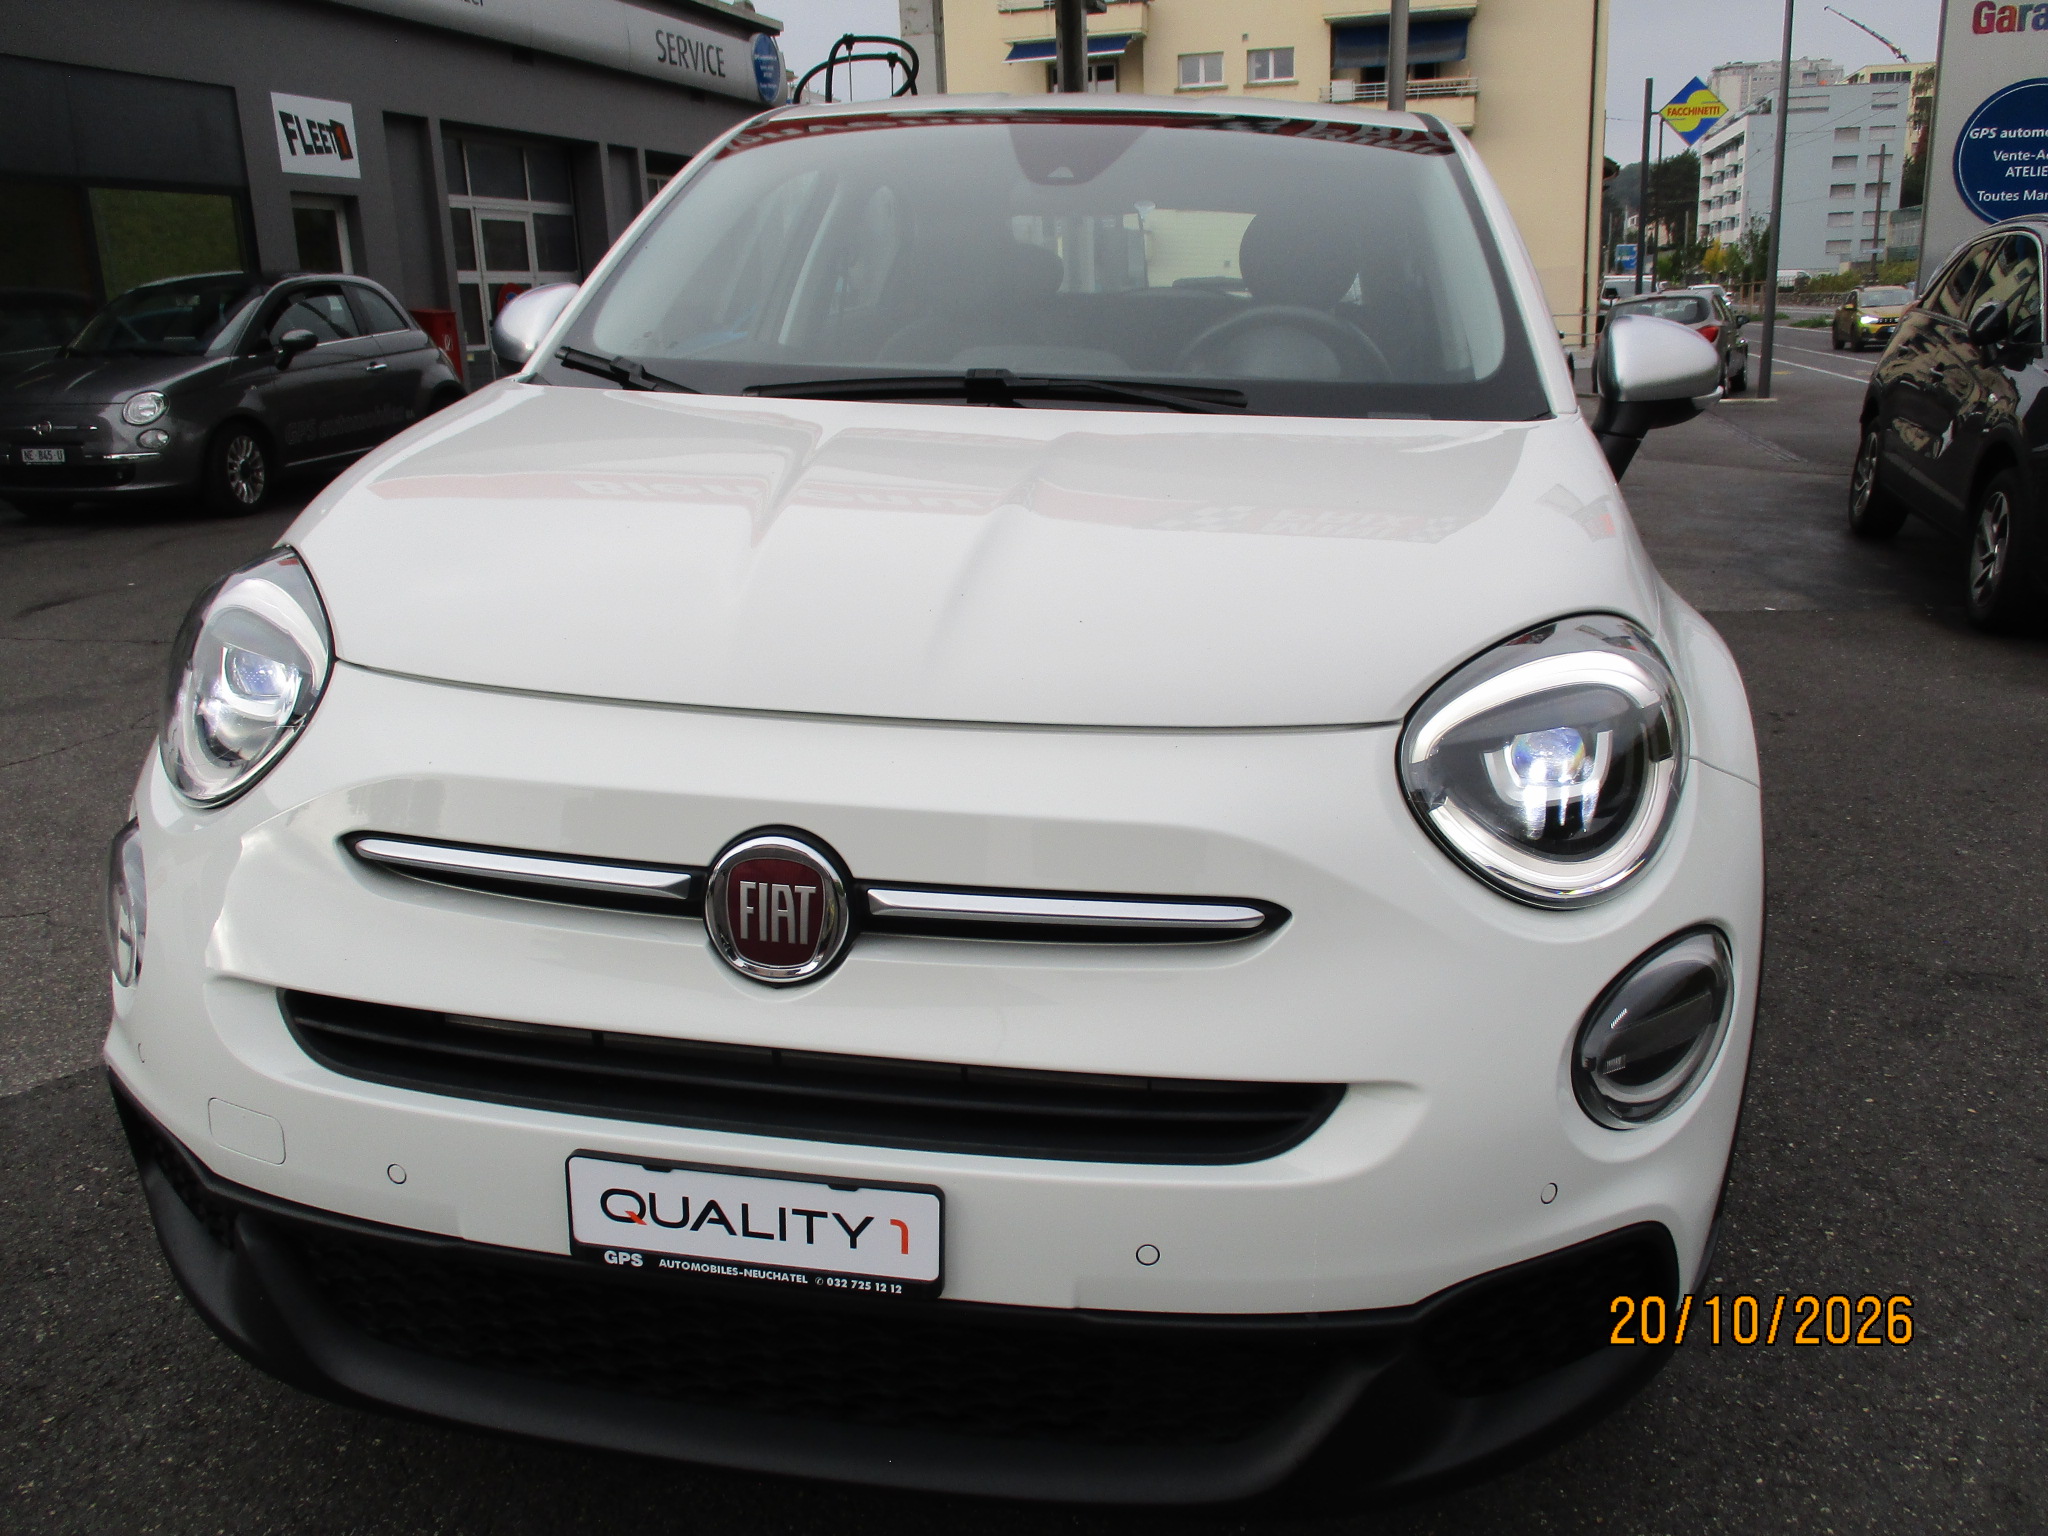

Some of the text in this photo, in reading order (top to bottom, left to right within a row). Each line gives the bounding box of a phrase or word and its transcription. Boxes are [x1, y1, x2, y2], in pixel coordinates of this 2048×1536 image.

[655, 29, 726, 78] SERVICE
[1667, 105, 1720, 116] FACCHINETTI
[1969, 127, 1998, 139] GPS
[1993, 149, 2048, 161] Vente-A
[1977, 190, 2020, 202] Toutes
[739, 880, 817, 945] FIAT
[599, 1187, 909, 1255] QUALITY 1
[604, 1250, 903, 1294] GPS AUTOMOBILES-NEUCHATEL 032 725 12 12
